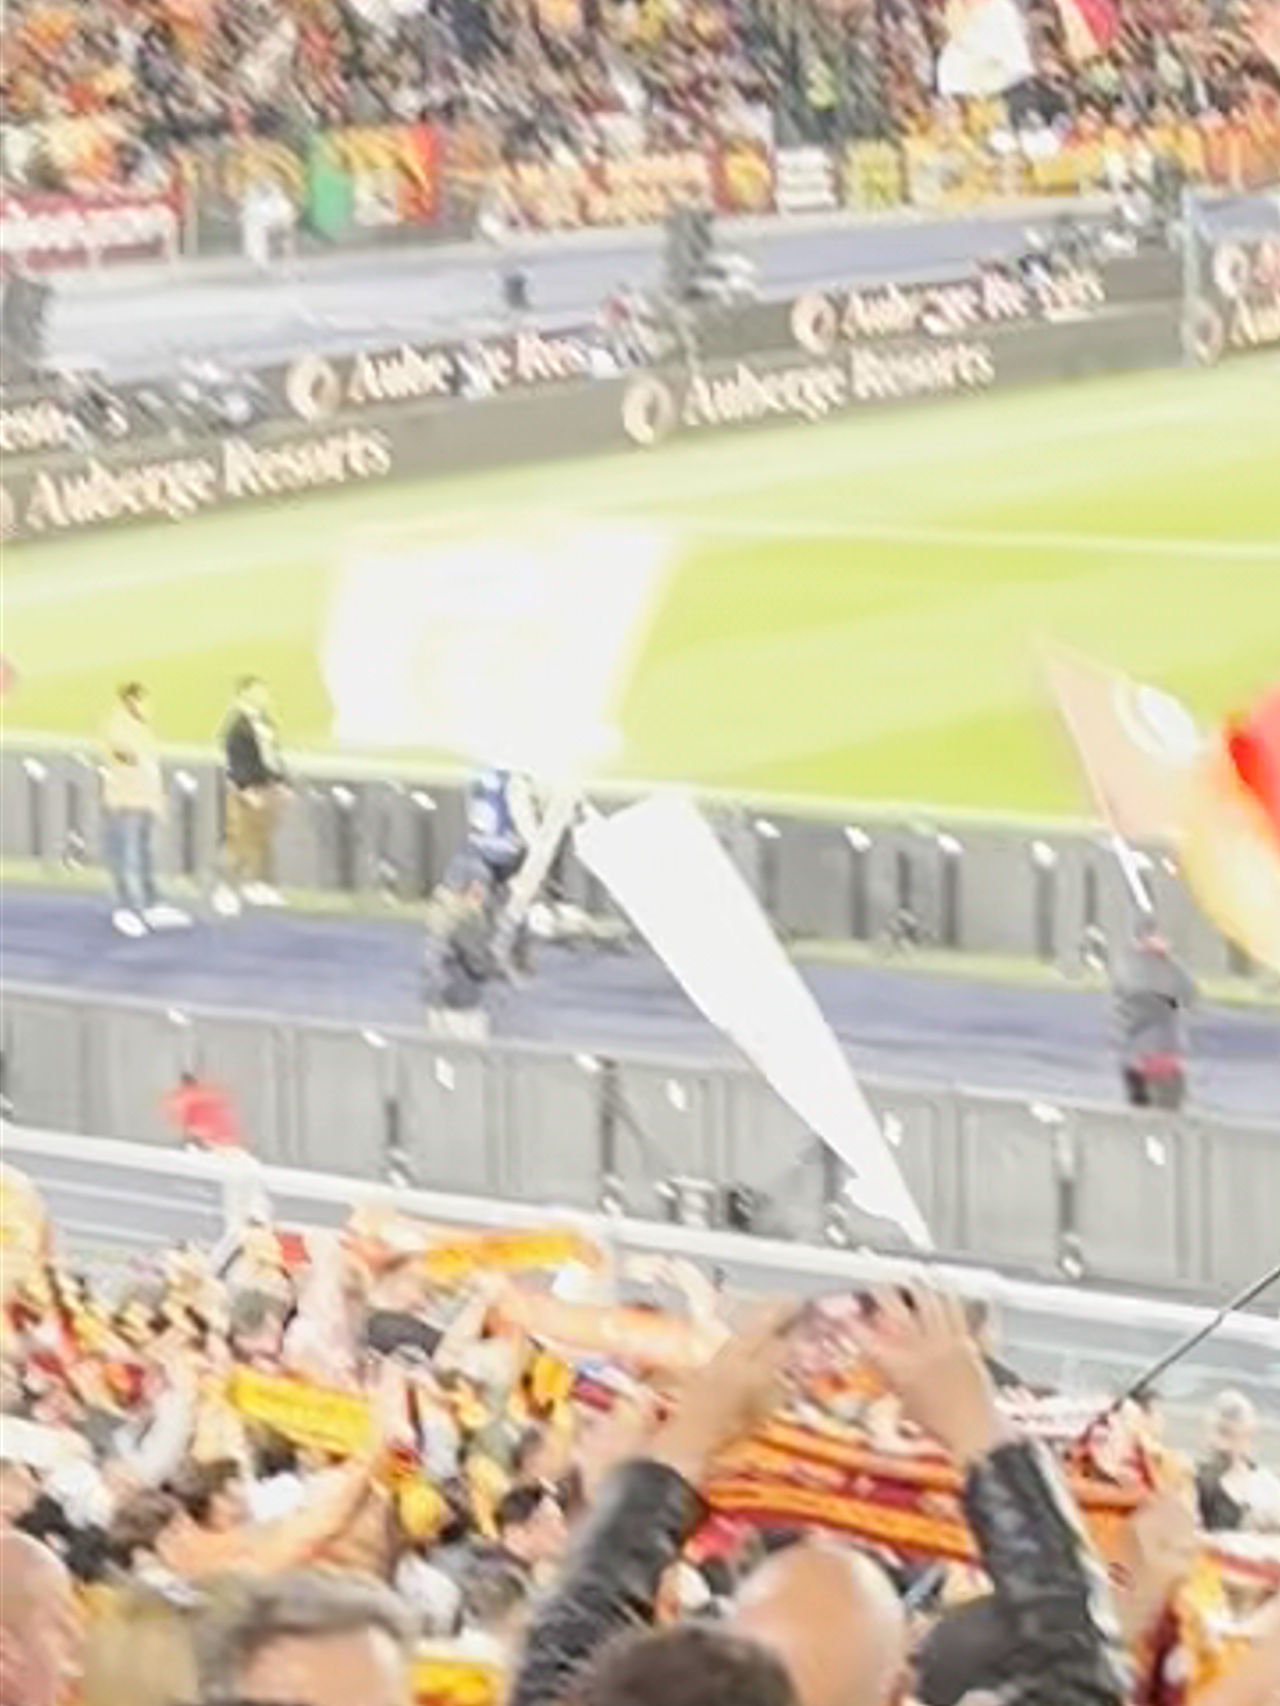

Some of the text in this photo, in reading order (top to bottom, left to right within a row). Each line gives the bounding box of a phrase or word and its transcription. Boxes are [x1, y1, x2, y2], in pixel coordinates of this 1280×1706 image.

[683, 342, 996, 426] Auberge Resorts
[26, 424, 393, 527] Auberge Resorts
